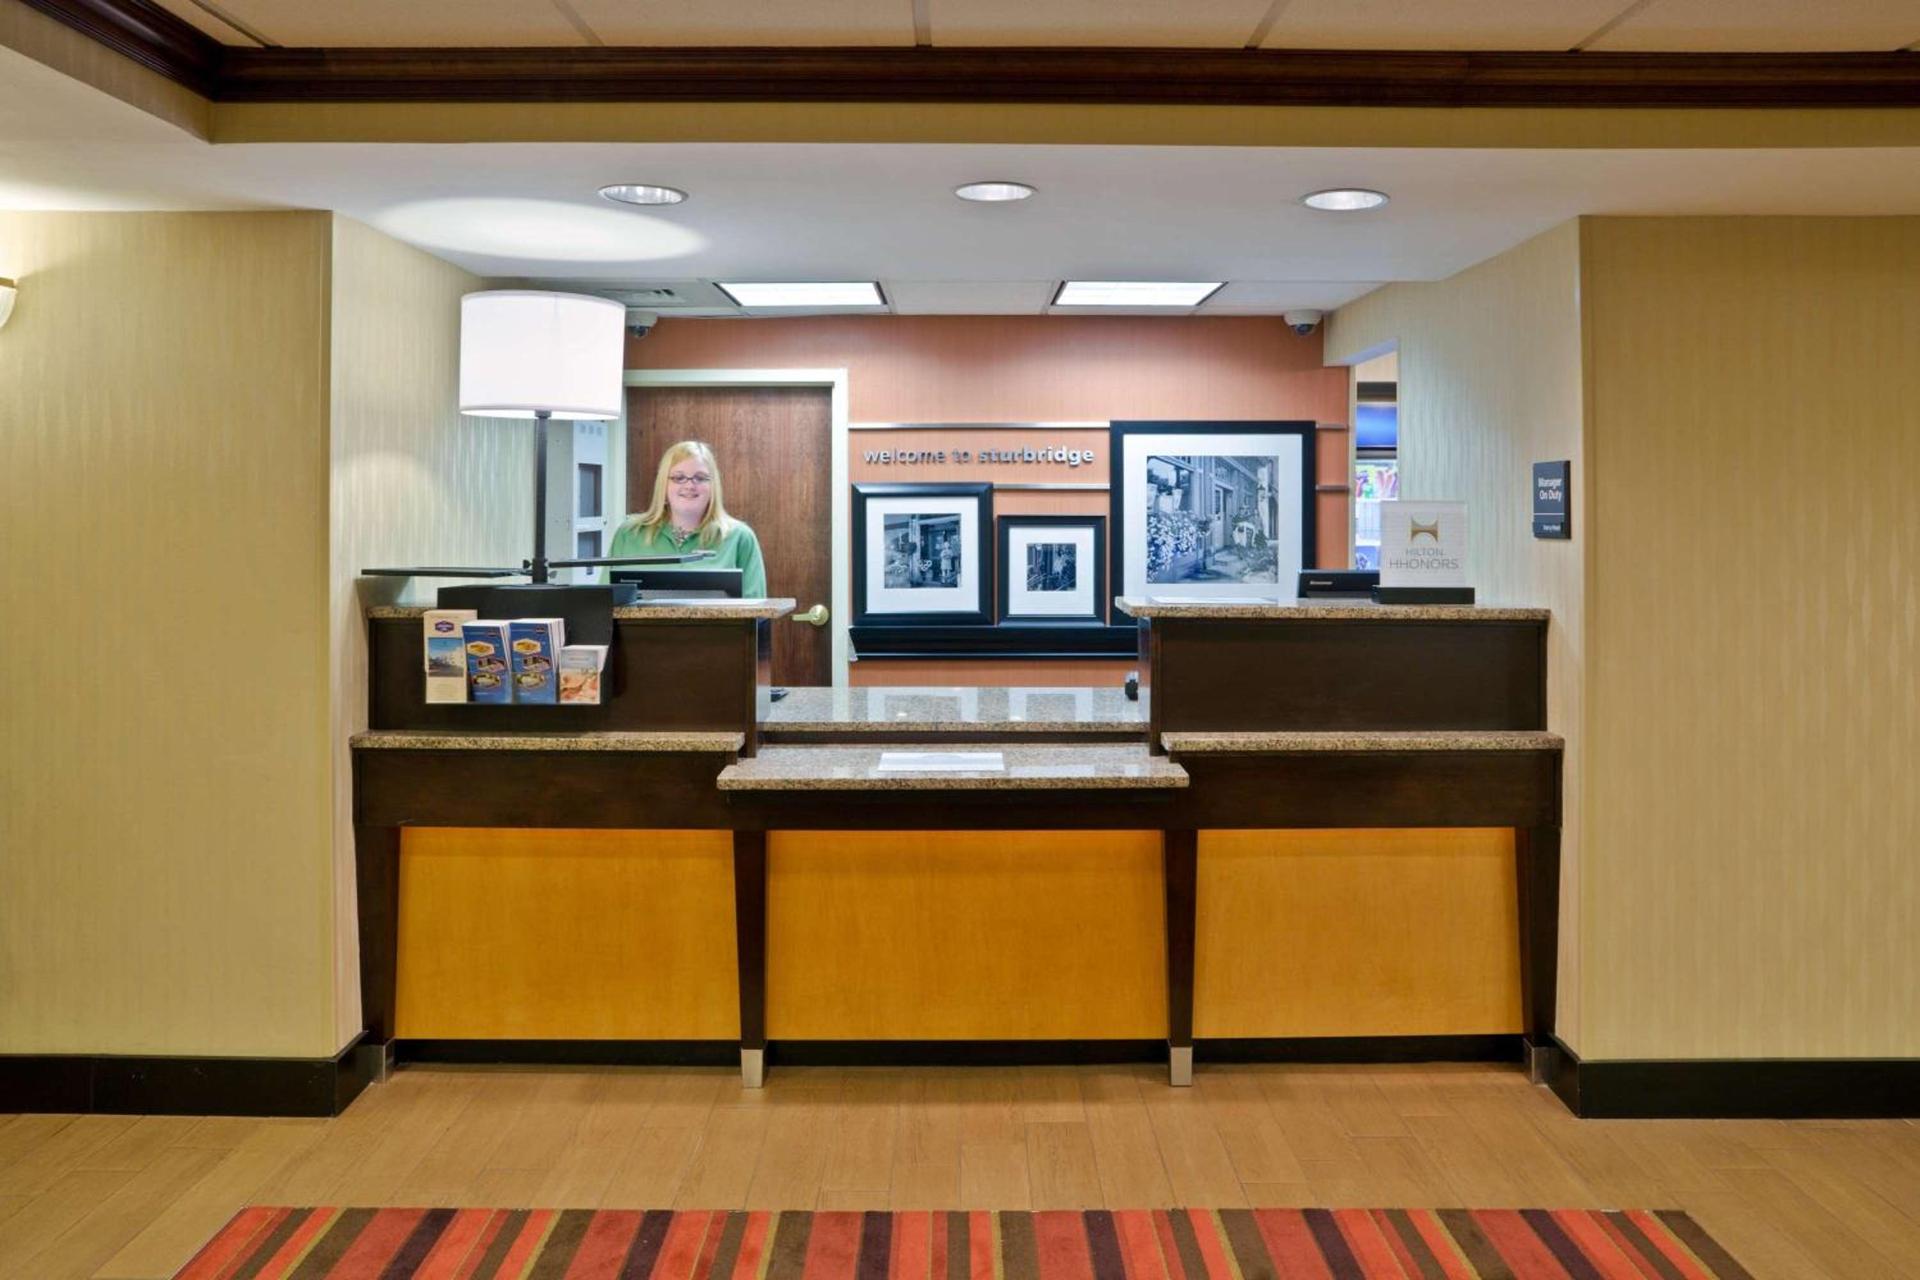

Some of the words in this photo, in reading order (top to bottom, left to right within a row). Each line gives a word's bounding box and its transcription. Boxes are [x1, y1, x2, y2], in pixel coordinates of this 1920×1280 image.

[863, 447, 946, 465] welcome
[952, 448, 971, 464] to
[978, 445, 1095, 468] sturbridge
[1539, 489, 1548, 500] On
[1548, 489, 1562, 502] Duty
[1406, 547, 1444, 557] HILTON
[1389, 558, 1460, 570] HHONORS
